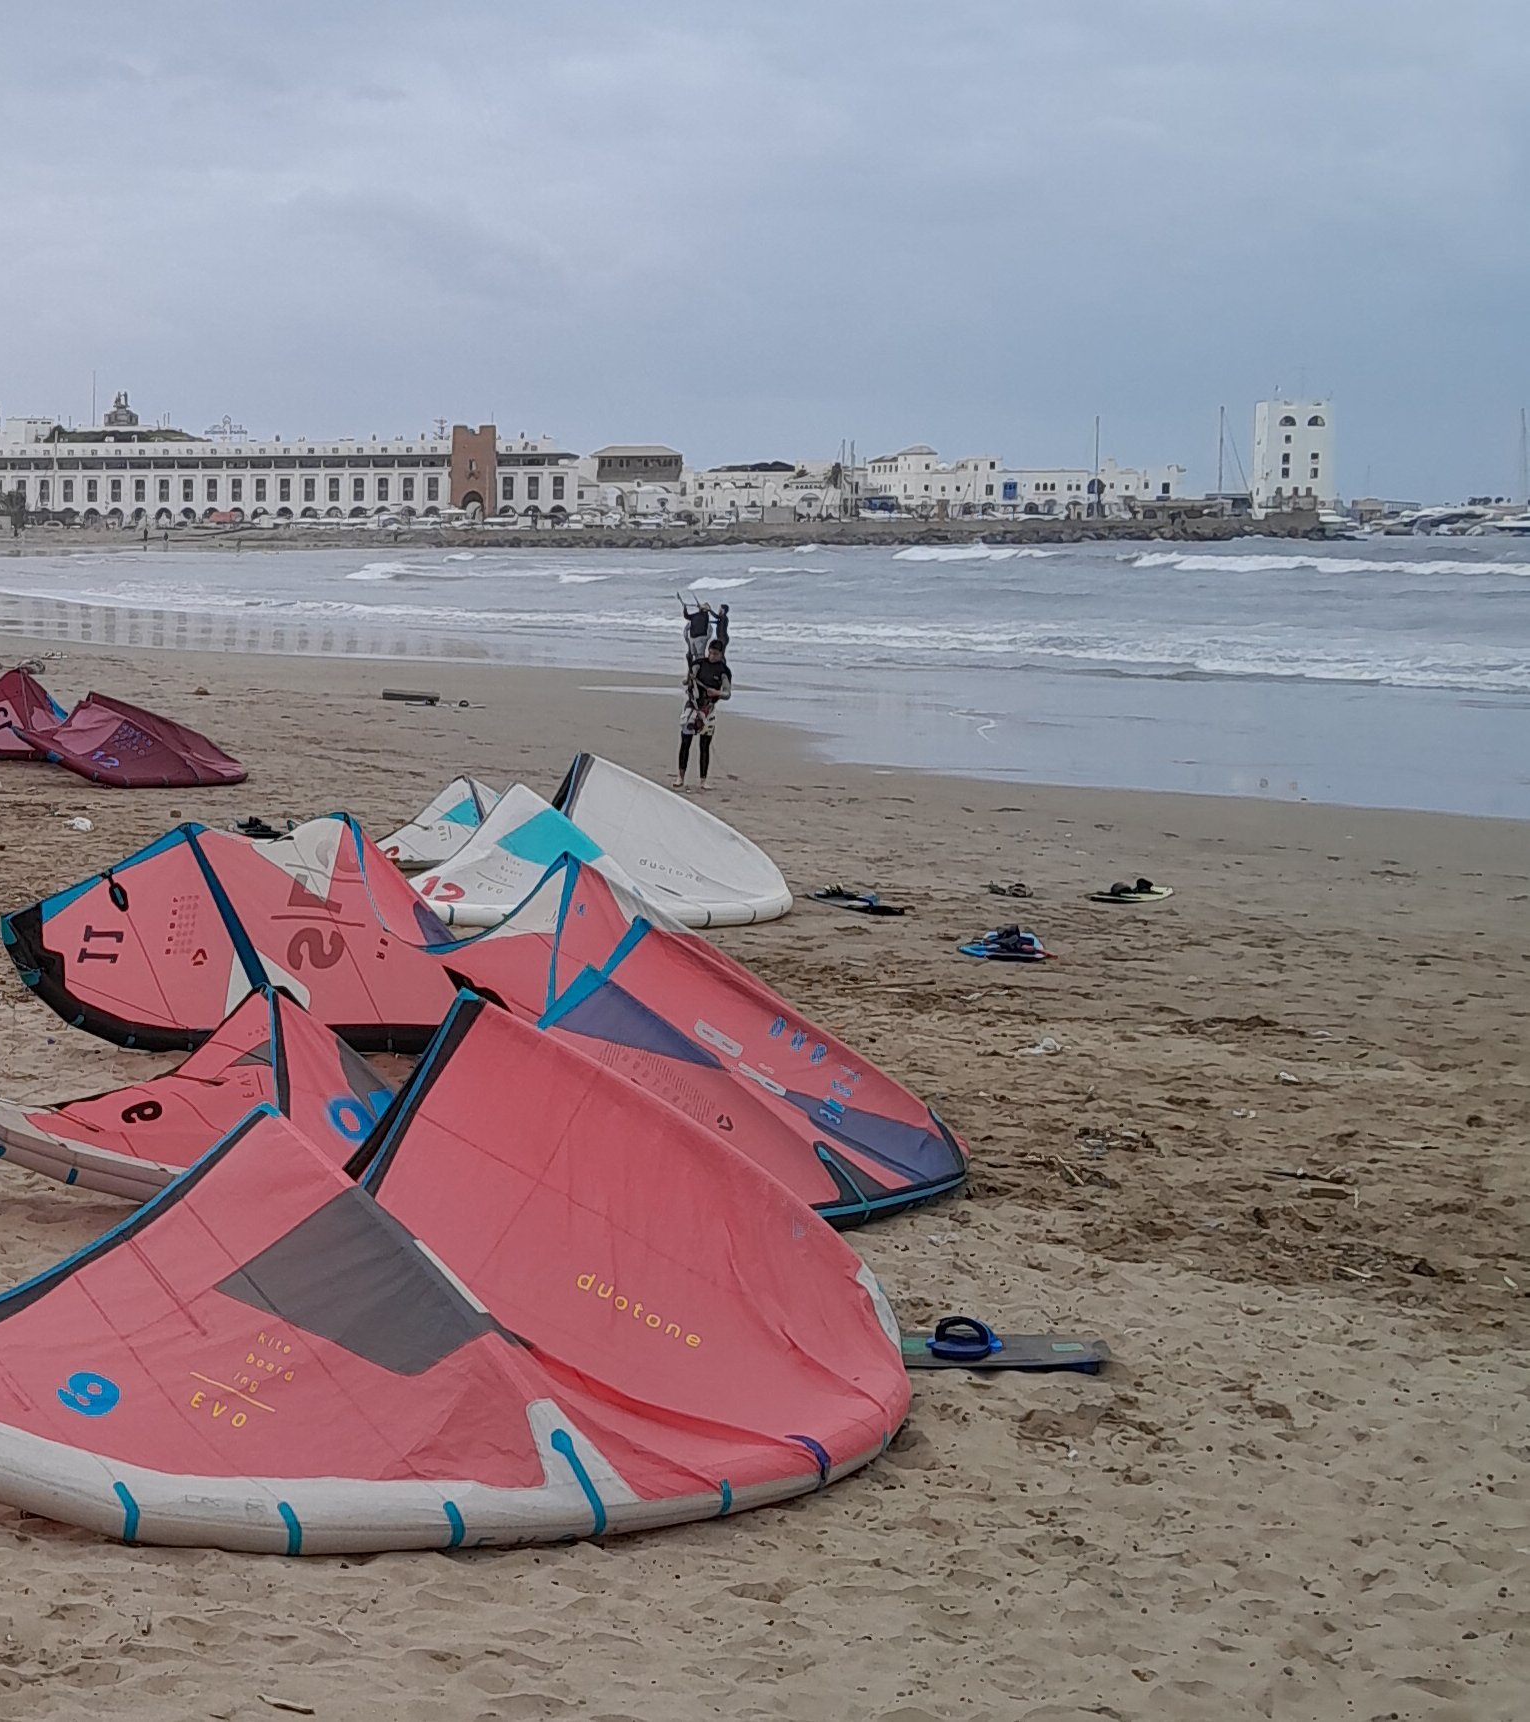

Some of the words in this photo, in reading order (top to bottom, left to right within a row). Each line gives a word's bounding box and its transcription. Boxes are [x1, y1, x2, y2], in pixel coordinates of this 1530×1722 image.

[421, 875, 466, 902] 12
[576, 1273, 702, 1348] duotone
[257, 1332, 292, 1354] kite
[245, 1353, 295, 1382] board
[57, 1371, 121, 1418] 9
[190, 1391, 248, 1428] EVO
